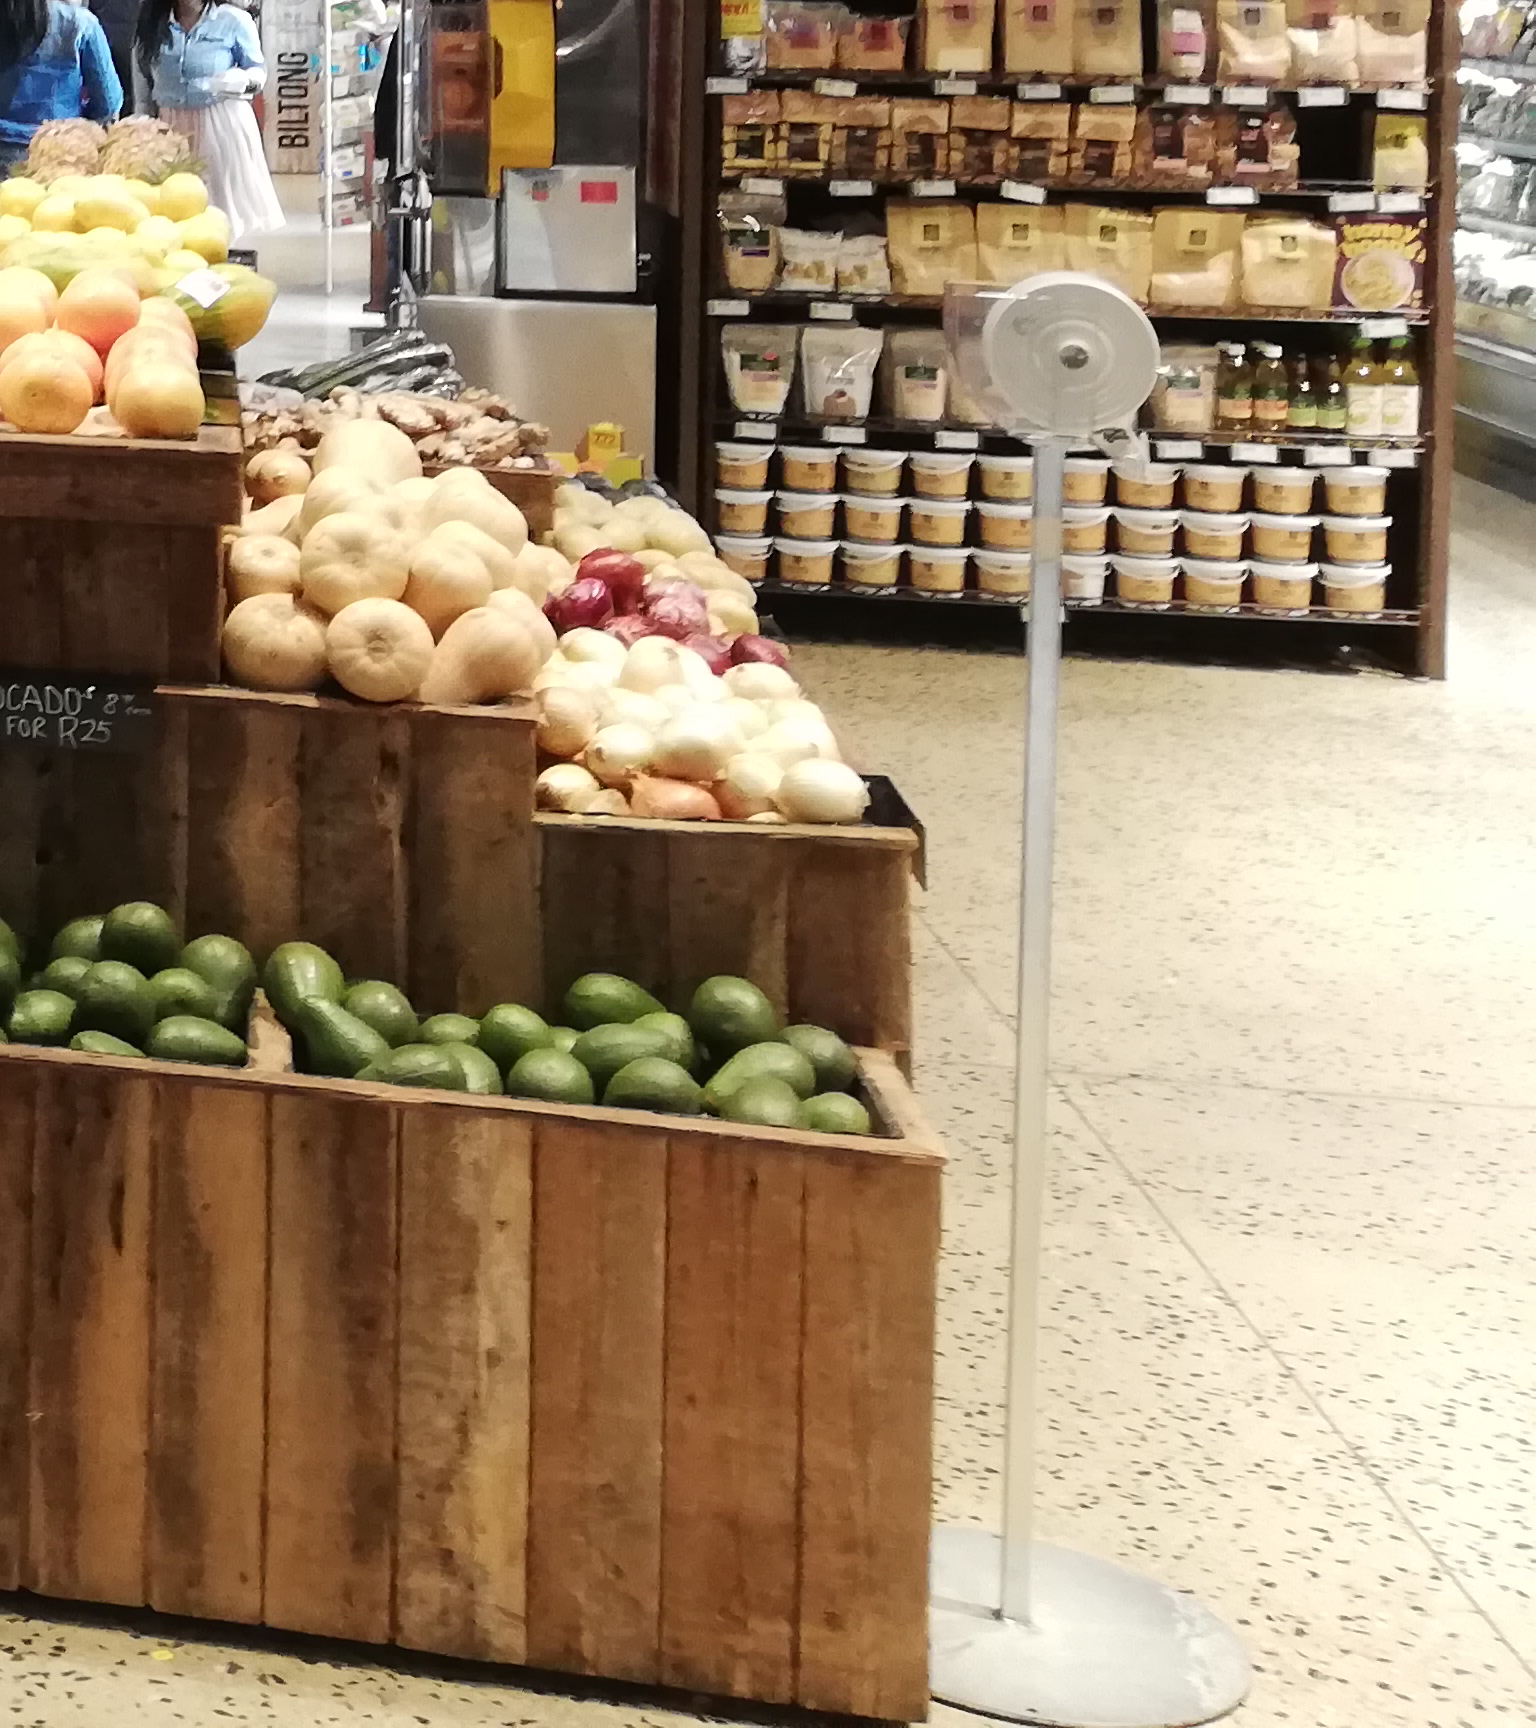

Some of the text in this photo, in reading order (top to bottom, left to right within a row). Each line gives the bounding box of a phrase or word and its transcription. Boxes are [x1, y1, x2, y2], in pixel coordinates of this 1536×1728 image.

[278, 52, 309, 149] BILTONG
[6, 716, 47, 739] FOR
[58, 715, 113, 749] R25
